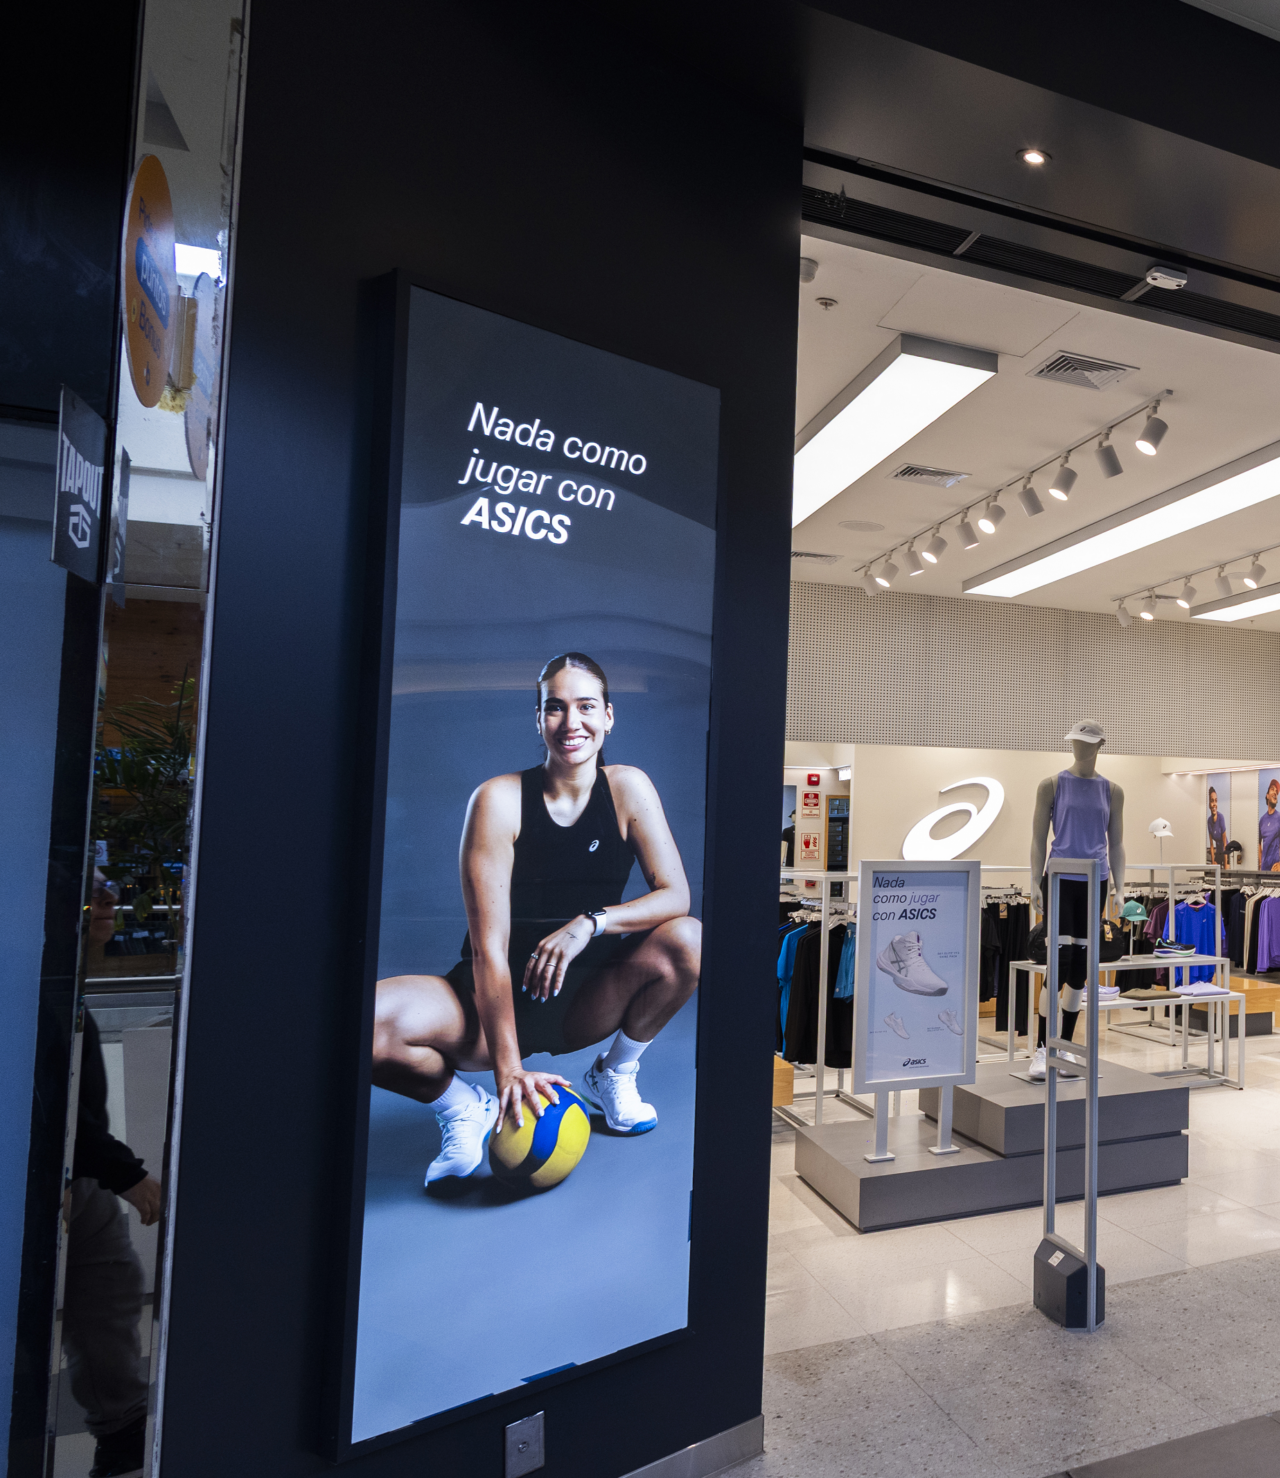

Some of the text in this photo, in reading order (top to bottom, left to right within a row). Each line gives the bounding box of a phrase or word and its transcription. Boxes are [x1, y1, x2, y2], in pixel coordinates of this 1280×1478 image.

[141, 253, 167, 316] puntos
[139, 301, 161, 360] Bonus
[467, 402, 647, 475] Nada como
[61, 431, 104, 519] TAPOUT
[458, 448, 616, 511] jugar con
[460, 497, 571, 544] ASICS
[873, 877, 905, 888] Nada
[873, 892, 940, 906] como jugar
[872, 908, 937, 921] con ASICS
